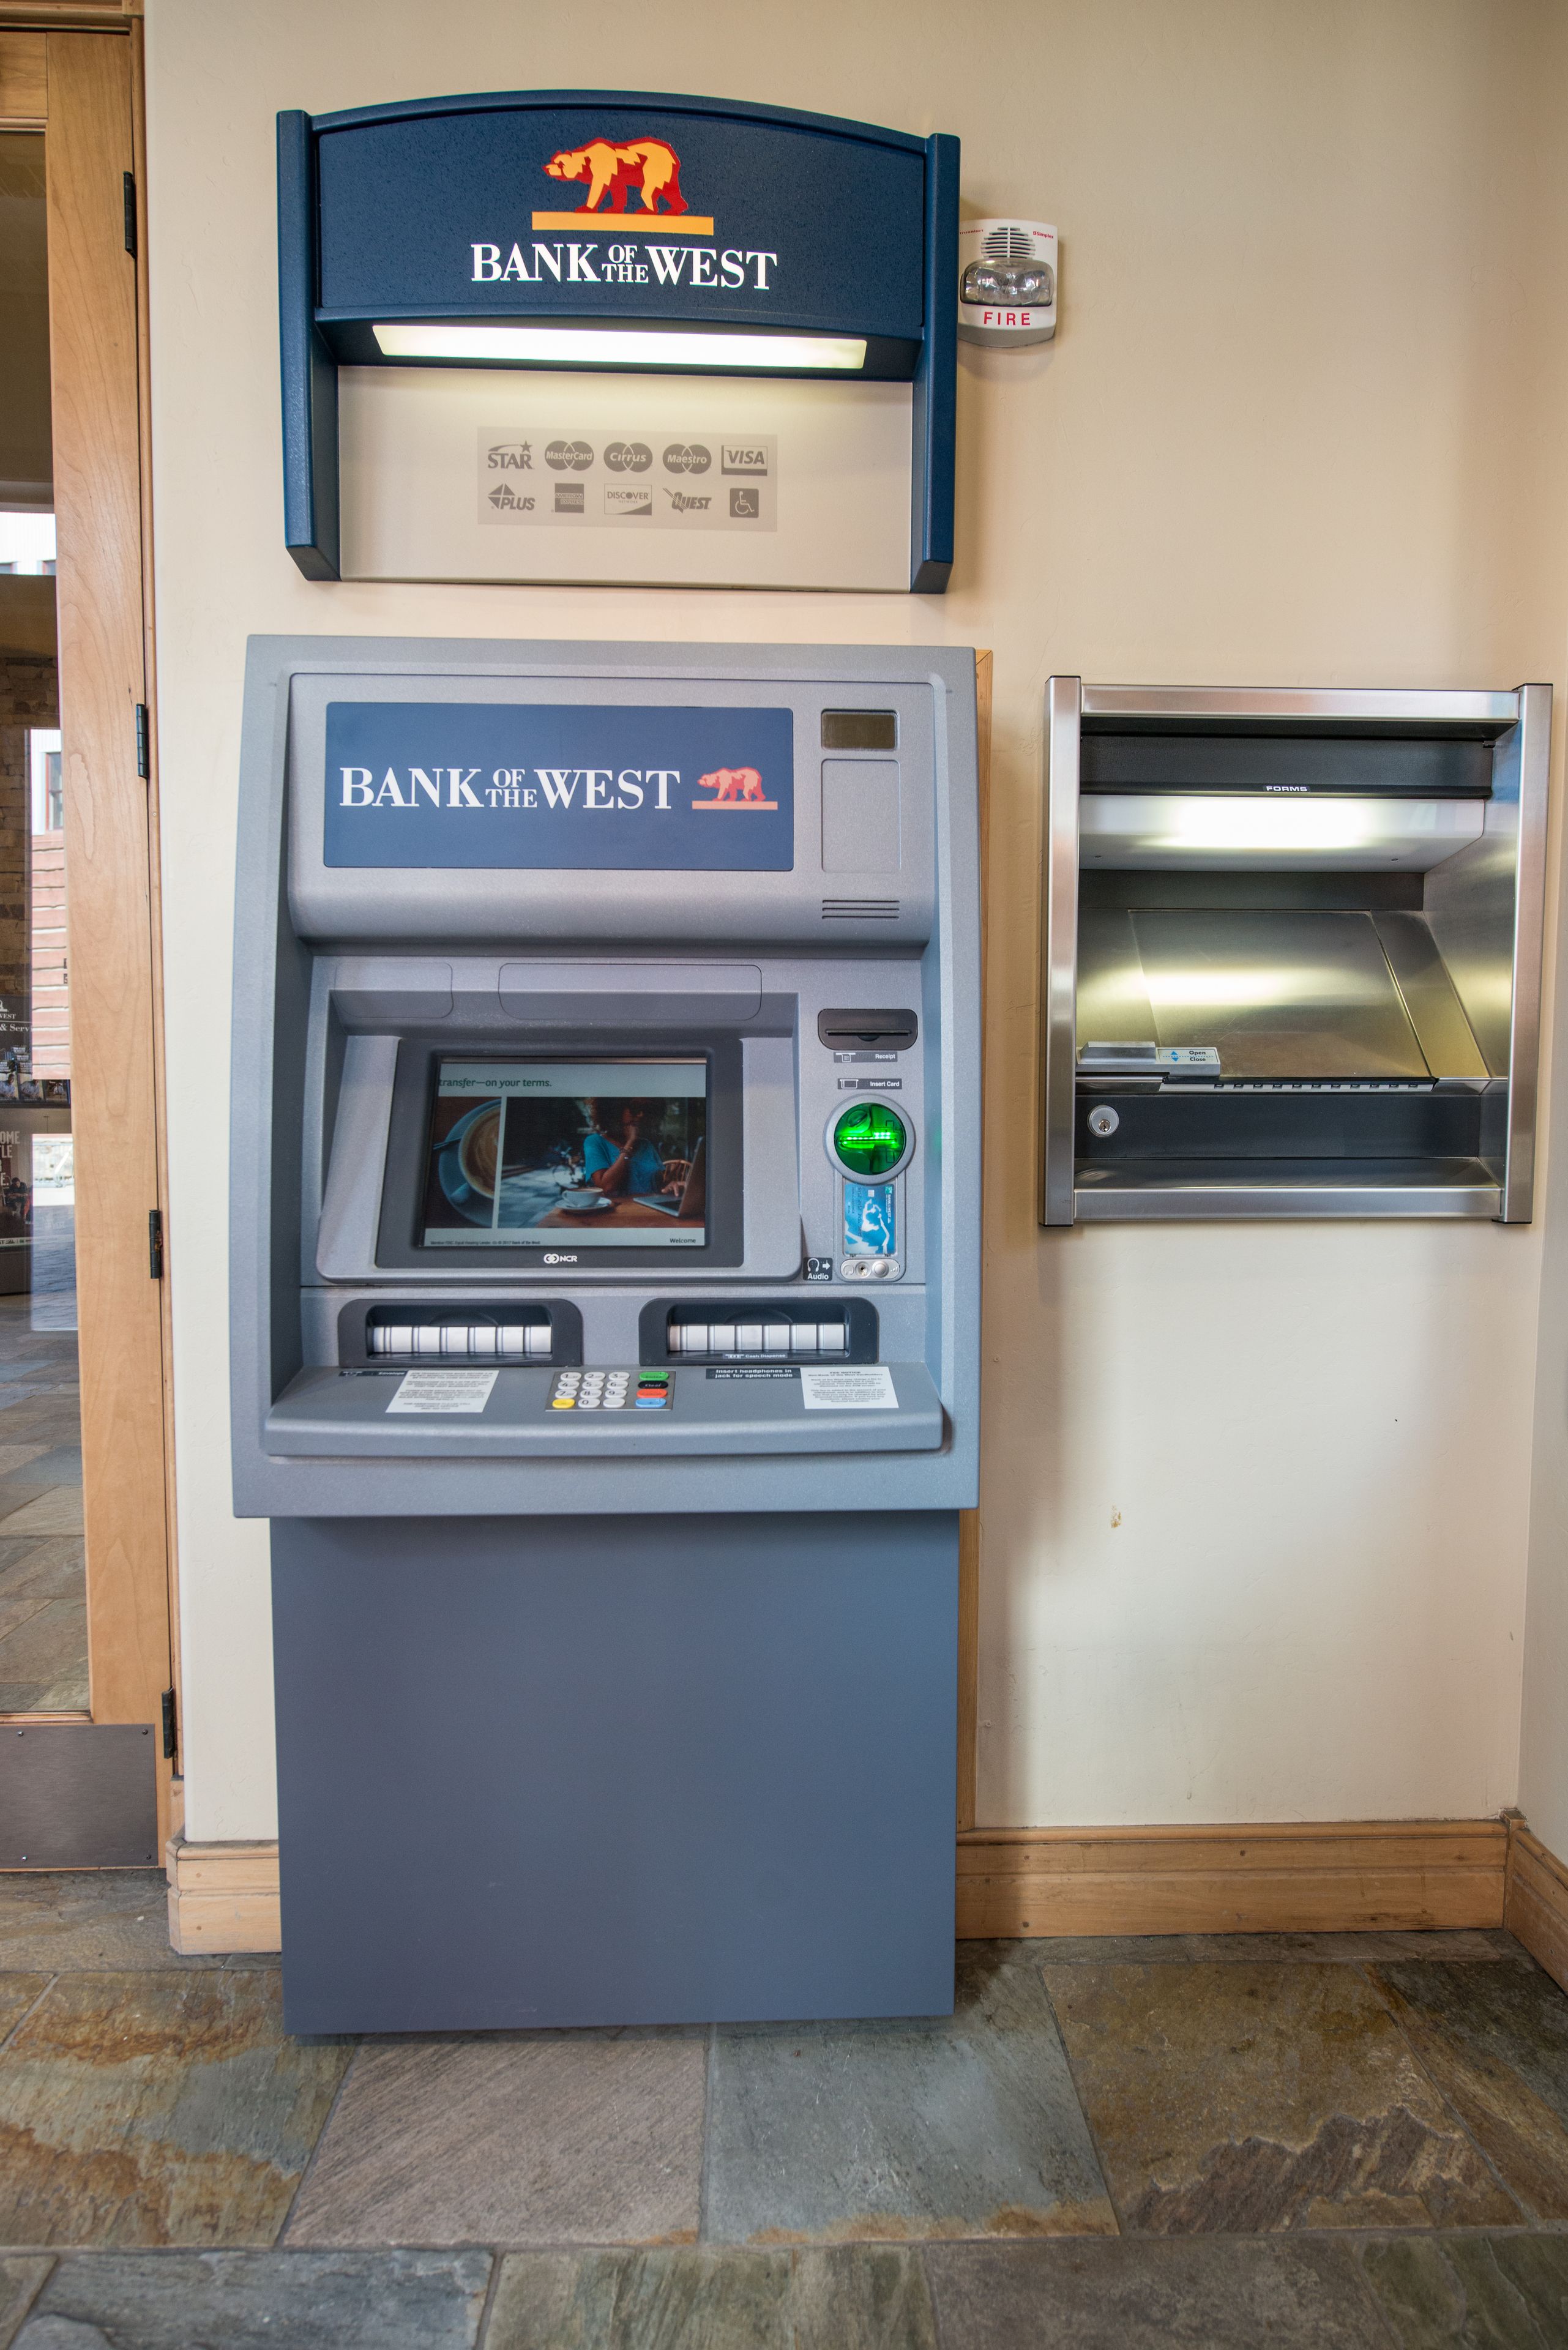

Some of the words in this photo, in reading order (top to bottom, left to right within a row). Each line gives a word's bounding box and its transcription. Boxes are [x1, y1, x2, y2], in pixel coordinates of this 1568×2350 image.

[471, 242, 602, 283] BANK
[608, 244, 638, 264] OF
[601, 264, 649, 283] THE
[644, 245, 778, 290] WEST
[984, 311, 1031, 326] FIRE
[487, 453, 533, 470] STAR
[546, 450, 593, 461] MasterCard
[610, 452, 646, 463] Cirrus
[667, 453, 707, 464] Maestro
[725, 449, 765, 465] VISA
[499, 496, 536, 511] PLUS
[607, 491, 649, 500] DISCOVER
[671, 492, 712, 513] QUEST
[340, 767, 483, 808] BANK
[493, 769, 525, 788] OF
[485, 789, 537, 808] THE
[534, 769, 681, 810] WEST
[498, 1080, 521, 1089] your
